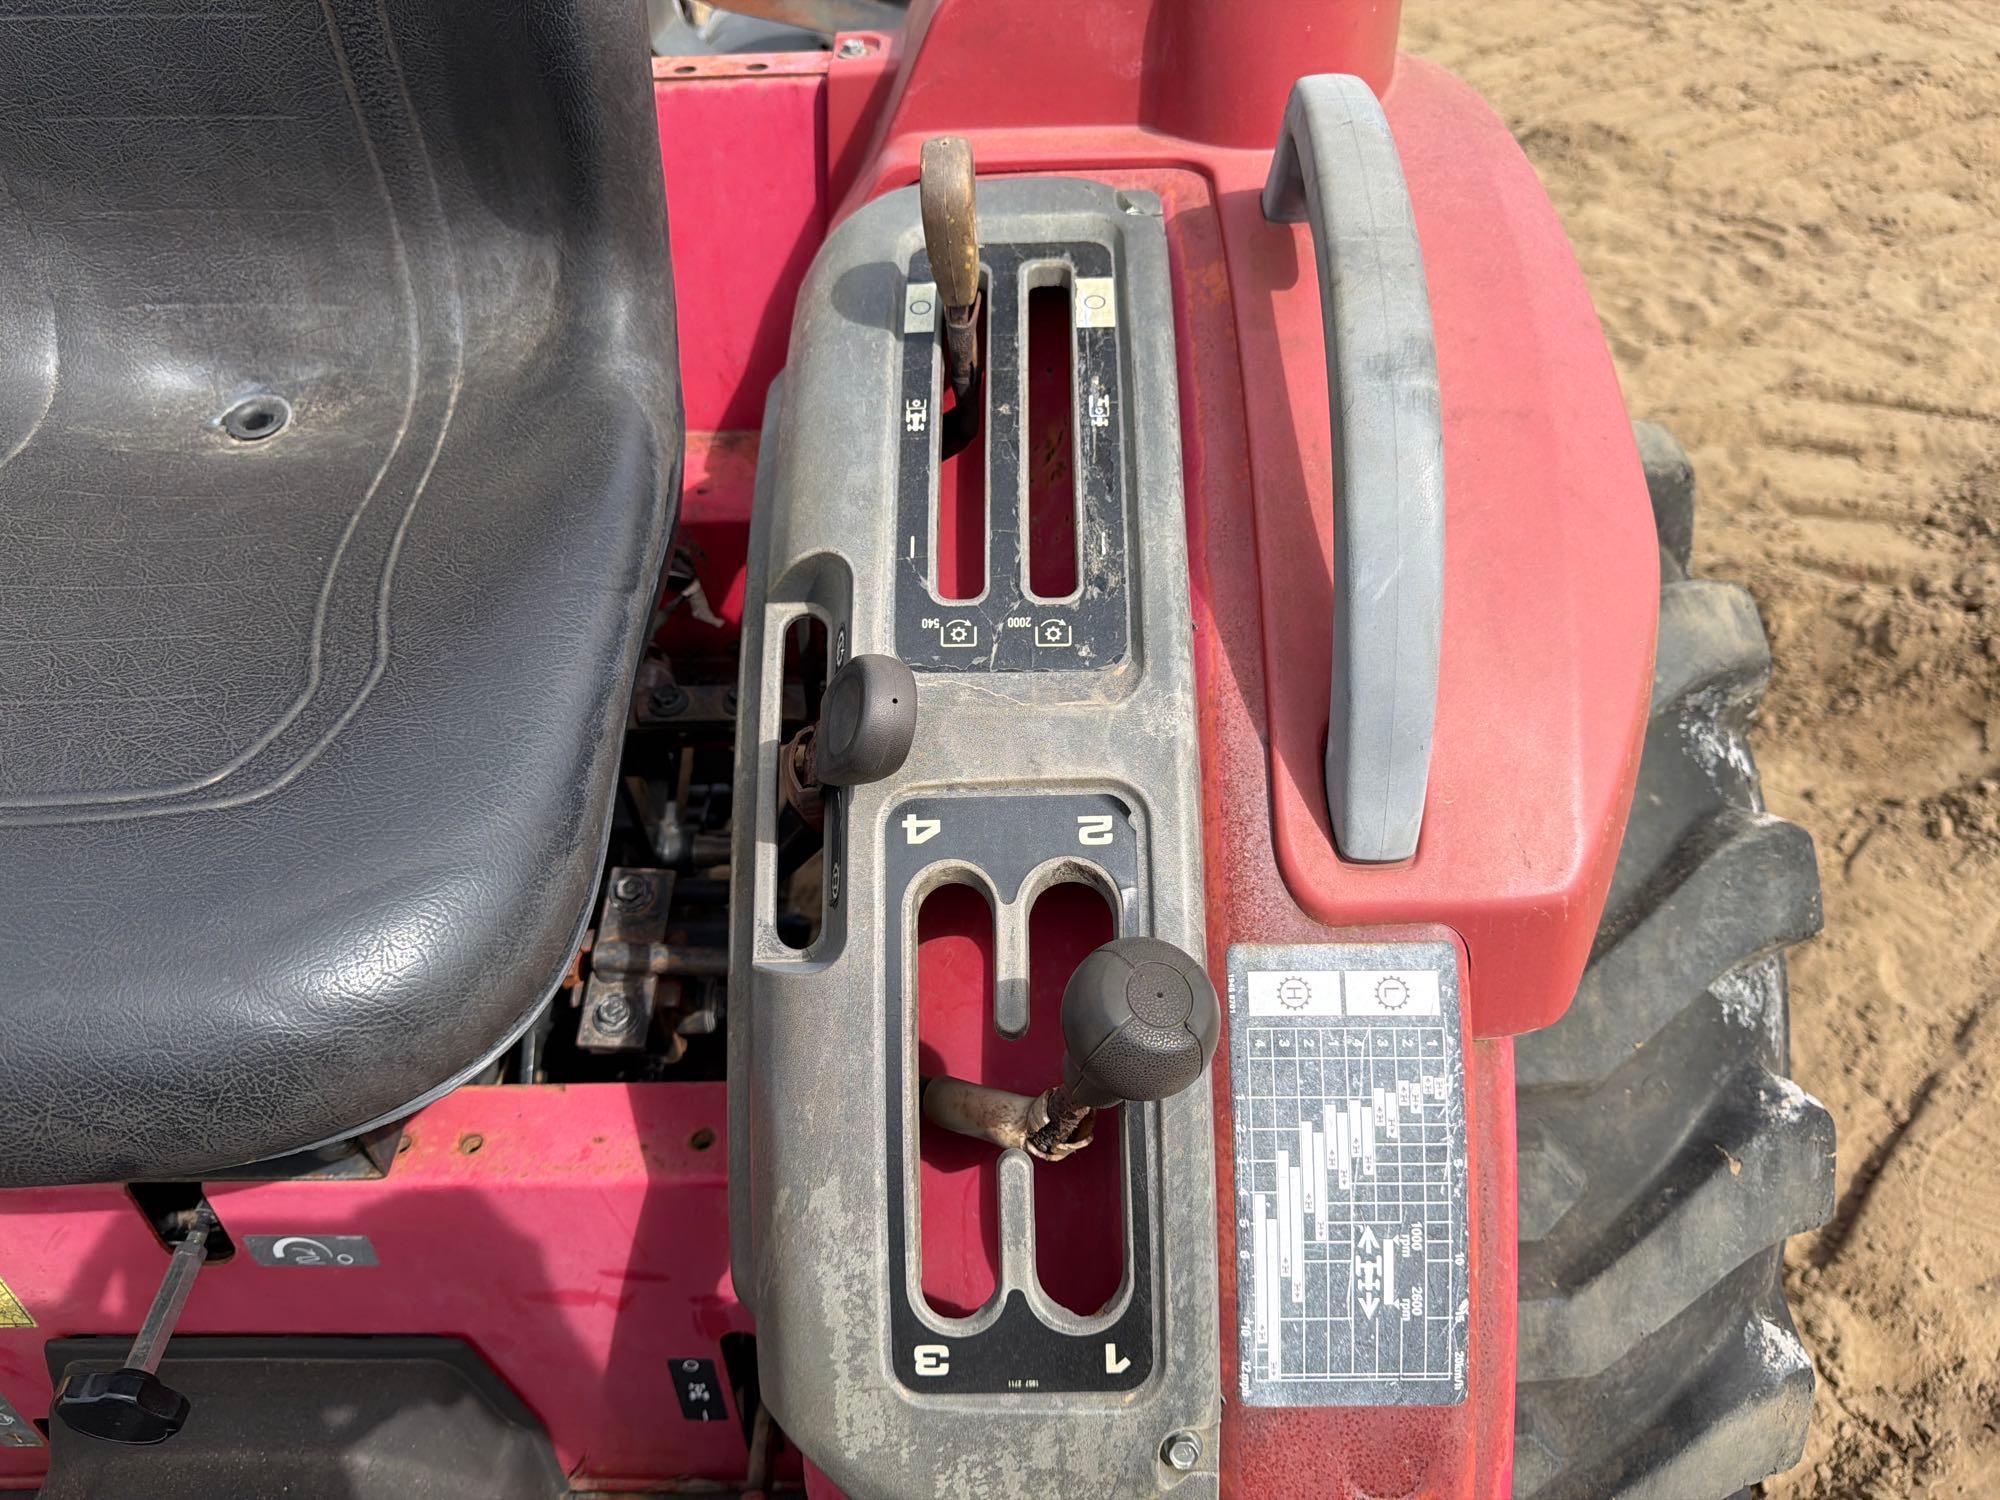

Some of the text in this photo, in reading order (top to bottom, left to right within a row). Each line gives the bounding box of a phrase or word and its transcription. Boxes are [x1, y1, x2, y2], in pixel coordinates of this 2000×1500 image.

[921, 618, 940, 630] 540
[1007, 616, 1032, 628] 2000
[901, 813, 941, 845] 4
[1077, 815, 1113, 846] 2
[1286, 987, 1302, 999] H
[1384, 987, 1399, 998] L
[1254, 1039, 1266, 1048] 4
[1279, 1039, 1290, 1048] 3
[1303, 1039, 1315, 1048] 2
[1328, 1039, 1339, 1047] 1
[1377, 1038, 1389, 1047] 3
[1402, 1038, 1413, 1047] 2
[1427, 1039, 1438, 1047] 1
[1411, 1221, 1422, 1251] 1000
[1401, 1234, 1410, 1258] rpm
[1455, 1252, 1464, 1266] 10
[1411, 1286, 1422, 1316] 2600
[1402, 1298, 1410, 1322] rpm
[914, 1345, 949, 1376] 3
[1105, 1343, 1131, 1374] 1
